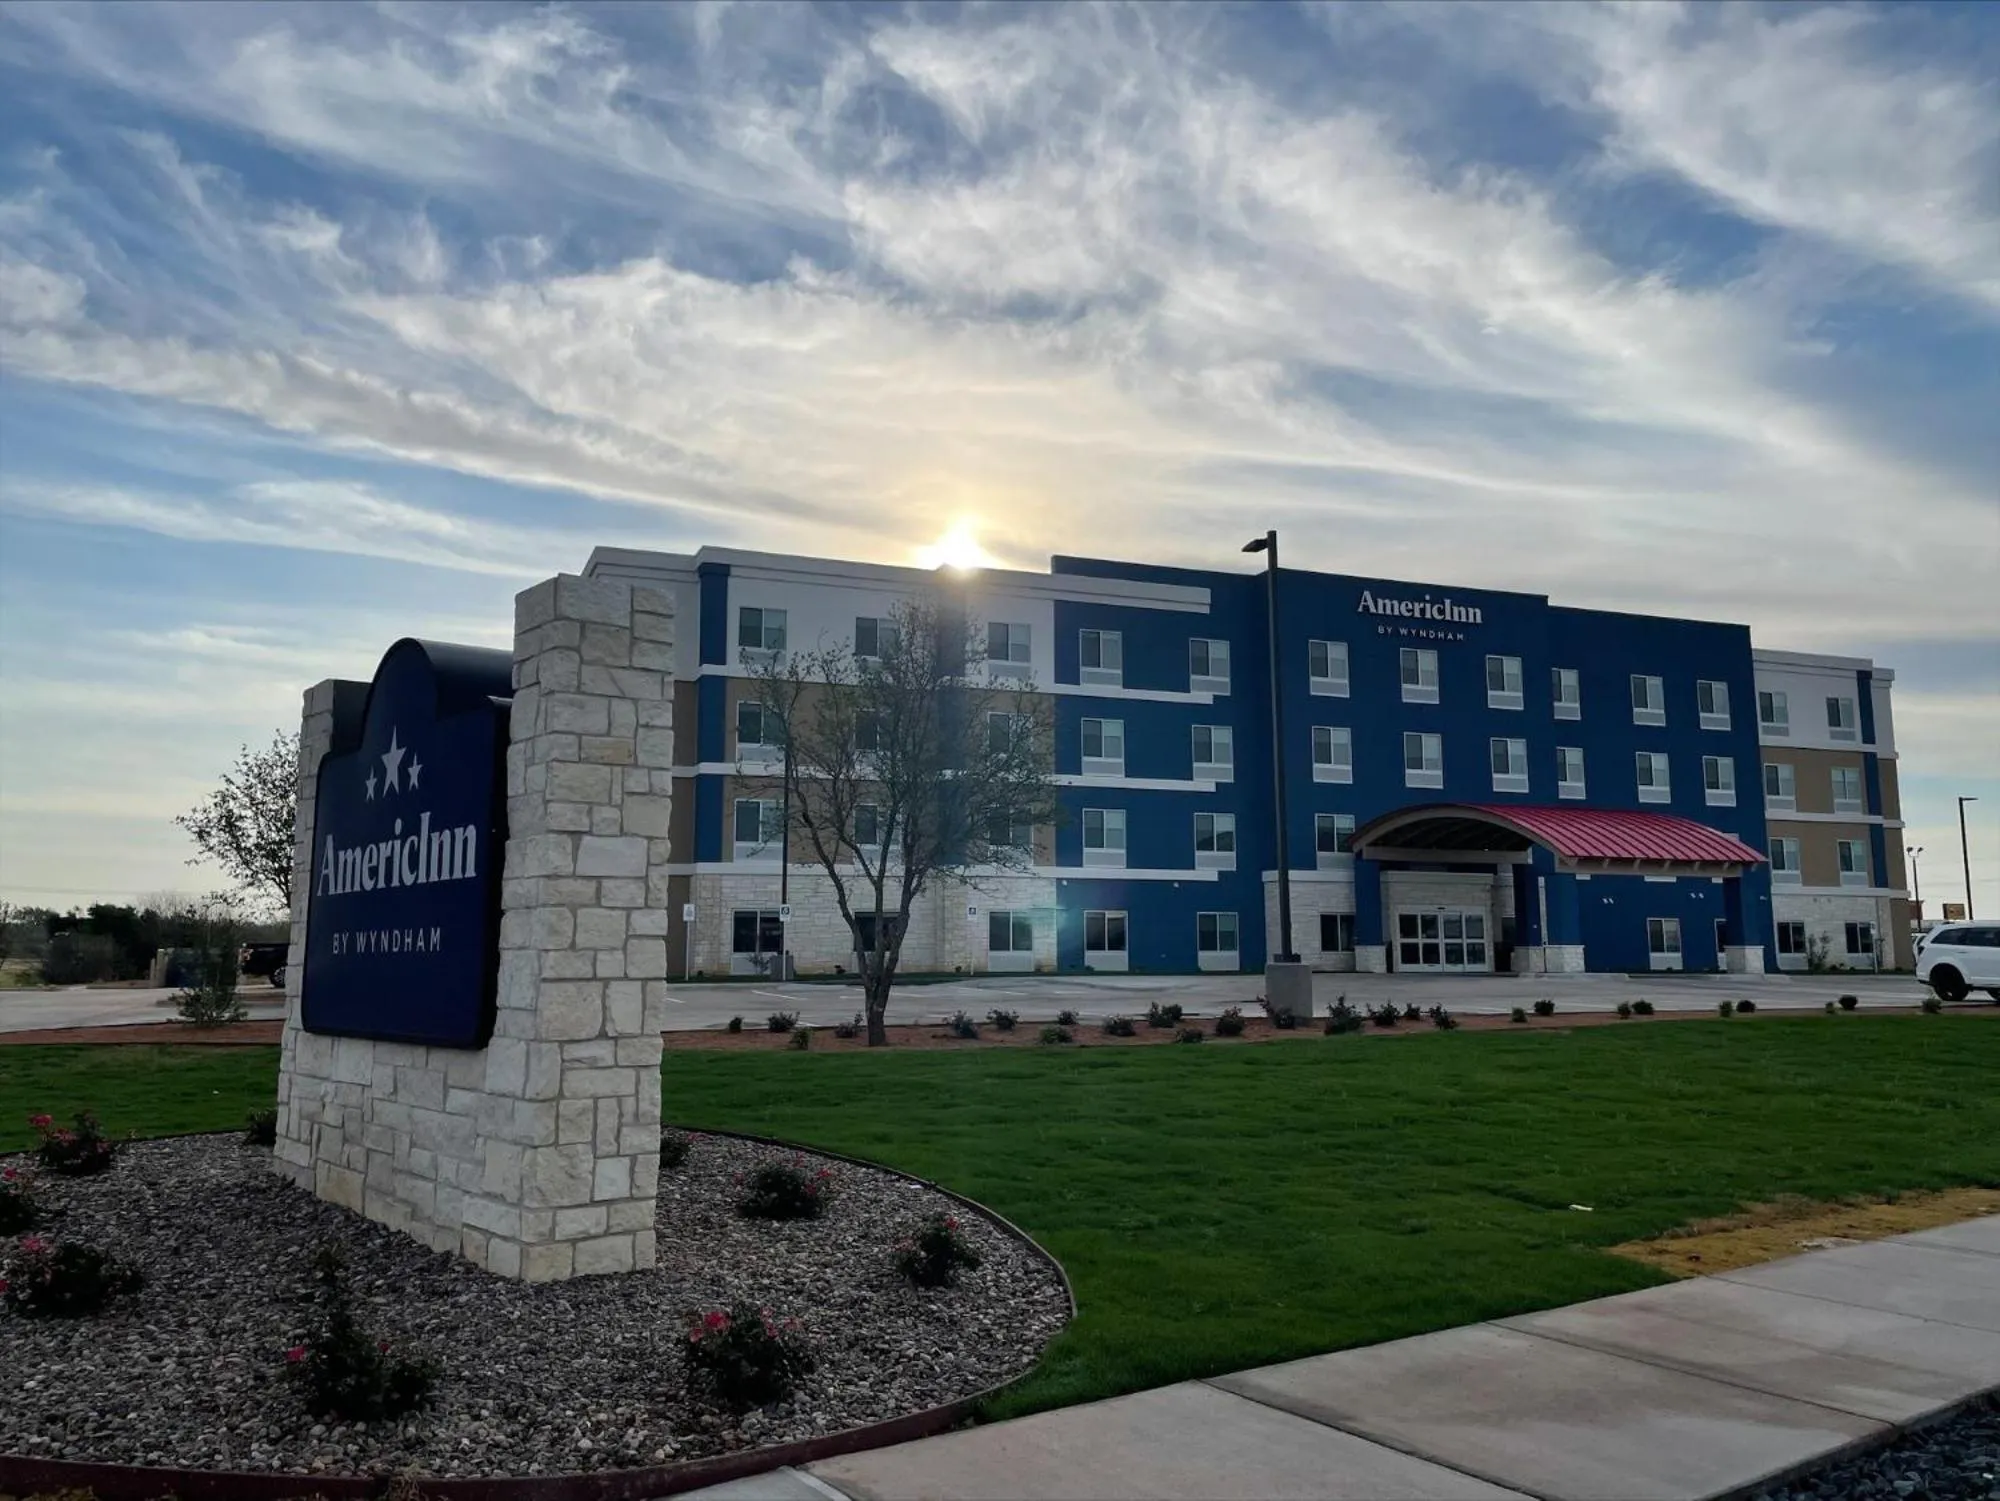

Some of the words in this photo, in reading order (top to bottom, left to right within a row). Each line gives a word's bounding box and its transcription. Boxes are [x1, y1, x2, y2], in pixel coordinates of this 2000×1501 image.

[1357, 590, 1483, 624] AmericInn
[1377, 625, 1393, 635] BY
[1399, 627, 1465, 641] WYNDHAM
[316, 811, 478, 897] AmericInn
[332, 931, 349, 954] BY
[356, 927, 442, 954] WYNDHAM
